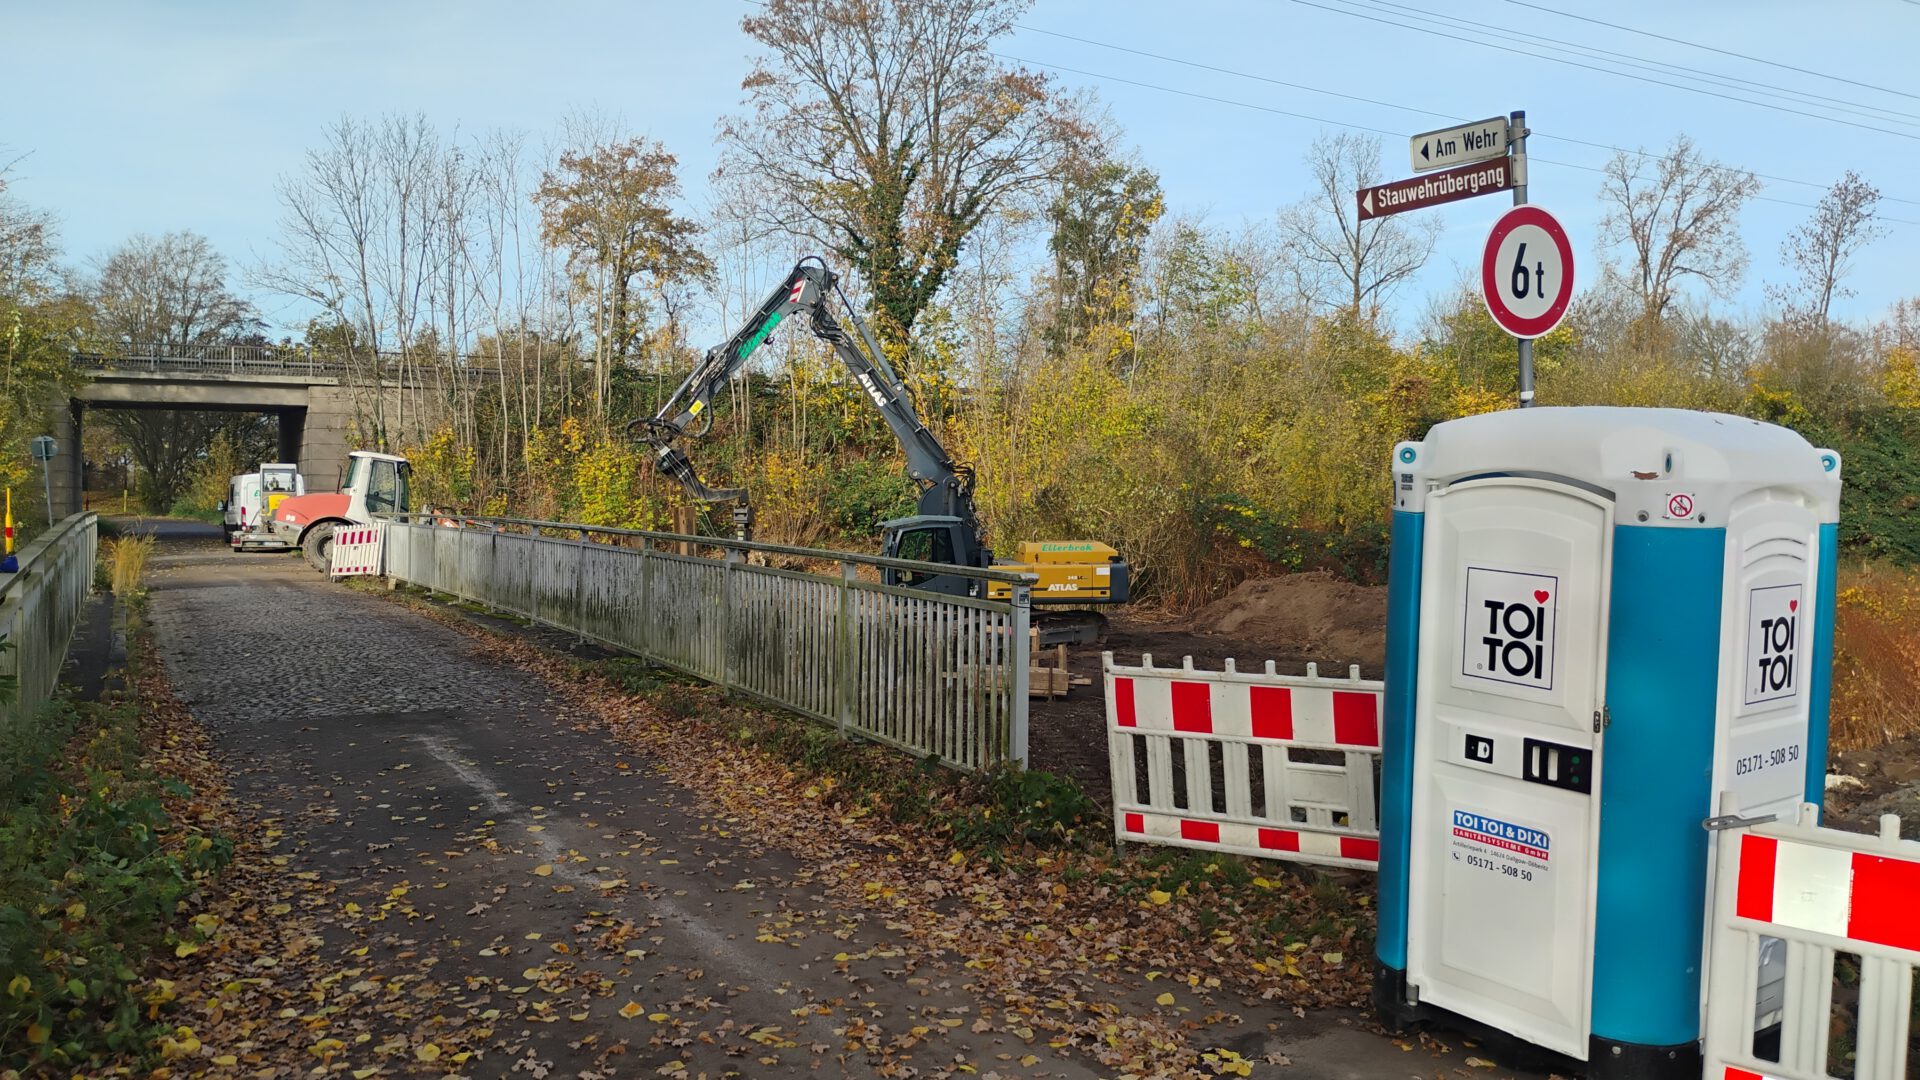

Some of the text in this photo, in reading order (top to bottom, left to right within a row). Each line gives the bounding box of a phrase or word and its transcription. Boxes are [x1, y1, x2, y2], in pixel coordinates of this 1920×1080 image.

[1435, 129, 1498, 158] Am Wehr
[1378, 166, 1505, 208] Stauwehrübergang
[858, 373, 887, 407] ATLAS
[1047, 583, 1078, 591] ATLAS
[1484, 600, 1545, 642] TOI
[1760, 616, 1795, 654] TOI
[1482, 636, 1544, 679] TOI
[1758, 654, 1793, 693] TOI
[1736, 754, 1763, 775] 05171
[1770, 748, 1785, 766] 508
[1788, 744, 1799, 761] 50
[1455, 812, 1547, 847] TOI TOI & DIXI
[1467, 855, 1494, 870] 05171
[1501, 864, 1518, 877] 508
[1520, 869, 1532, 881] 50
